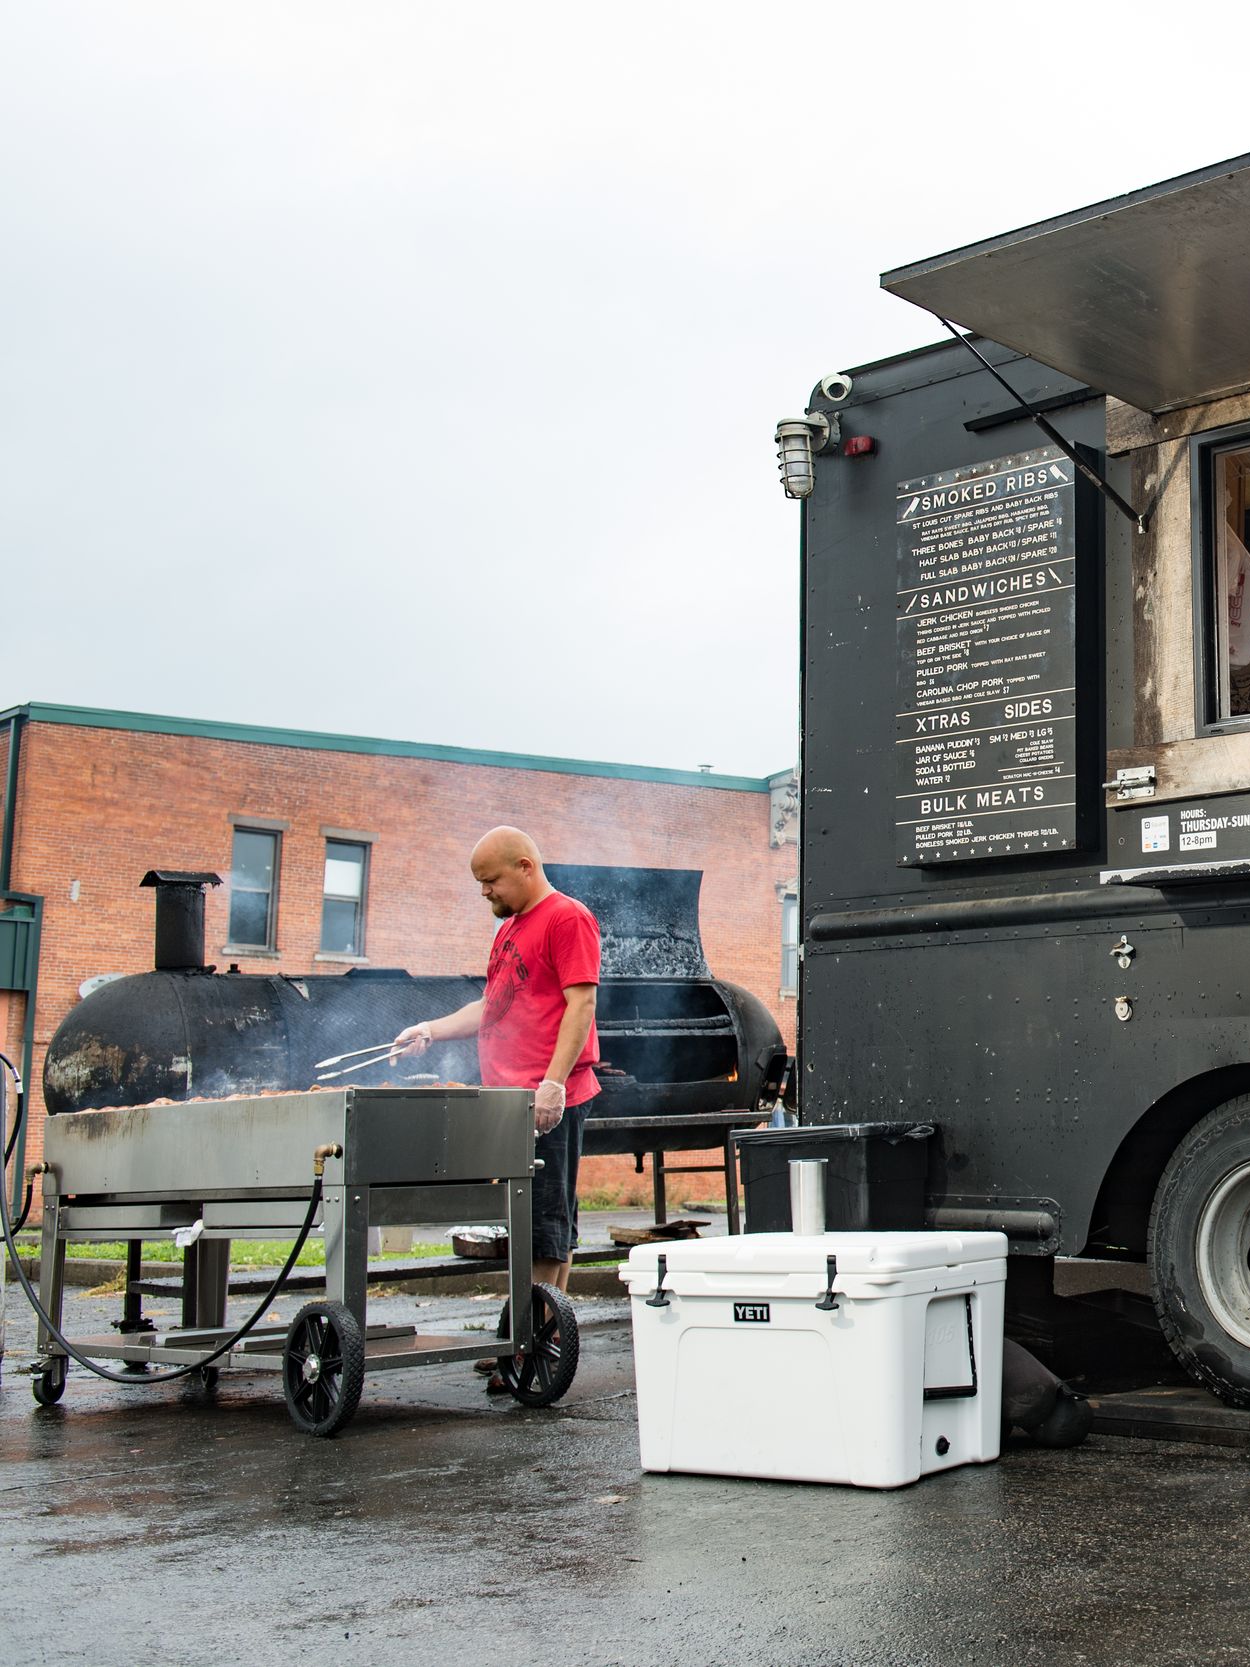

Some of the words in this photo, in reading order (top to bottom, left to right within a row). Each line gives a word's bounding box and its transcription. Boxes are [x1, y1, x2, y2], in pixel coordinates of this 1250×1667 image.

[922, 480, 997, 510] SMOKED
[1007, 470, 1047, 492] RIBS
[922, 519, 938, 527] LOUIS
[954, 511, 973, 521] SPARE
[975, 507, 989, 516] RIBS
[991, 504, 1004, 512] AND
[1006, 500, 1022, 509] BABY
[1024, 496, 1042, 504] BACK
[1044, 492, 1058, 500] RIBS
[912, 545, 936, 556] THREE
[939, 539, 963, 551] BONES
[968, 534, 989, 545] BABY
[992, 528, 1014, 539] BACK
[1023, 525, 1026, 533] /
[1028, 519, 1054, 532] SPARE
[919, 557, 937, 567] HALF
[940, 553, 959, 563] SLAB
[962, 547, 983, 558] BABY
[986, 542, 1008, 553] BACK
[1017, 539, 1021, 547] /
[1022, 533, 1048, 546] SPARE
[921, 572, 936, 581] FULL
[939, 567, 959, 577] SLAB
[962, 562, 982, 572] BABY
[985, 556, 1008, 567] BACK
[1017, 553, 1020, 561] /
[1021, 548, 1047, 560] SPARE
[921, 572, 1045, 608] SANDWICHES
[917, 617, 937, 627] JERK
[940, 610, 973, 623] CHICKEN
[917, 646, 936, 657] BEEF
[939, 640, 971, 653] BRISKET
[917, 666, 944, 677] PULLED
[947, 662, 968, 672] PORK
[917, 686, 954, 698] CAROLINA
[957, 681, 979, 691] CHOP
[982, 677, 1003, 688] PORK
[1003, 686, 1009, 694] $7
[1005, 699, 1052, 719] SIDES
[916, 711, 970, 732] XTRAS
[989, 735, 1001, 743] SM
[1010, 731, 1028, 740] MED
[1037, 728, 1047, 737] LG
[916, 743, 945, 754] BANANA
[947, 738, 974, 749] PUDDIN'
[916, 756, 930, 765] JAR
[932, 754, 941, 762] OF
[943, 750, 967, 761] SAUCE
[916, 766, 935, 776] SODA
[943, 761, 976, 772] BOTTLED
[916, 776, 943, 786] WATER
[921, 795, 967, 814] BULK
[977, 786, 1044, 807] MEATS
[1180, 809, 1207, 820] HOURS:
[932, 823, 956, 831] BRISKET
[916, 840, 944, 849] BONELESS
[945, 837, 969, 845] SMOKED
[989, 833, 1015, 841] CHICKEN
[1017, 830, 1039, 838] THIGHS
[1182, 836, 1213, 847] 12-8pm
[735, 1306, 768, 1320] YETI
